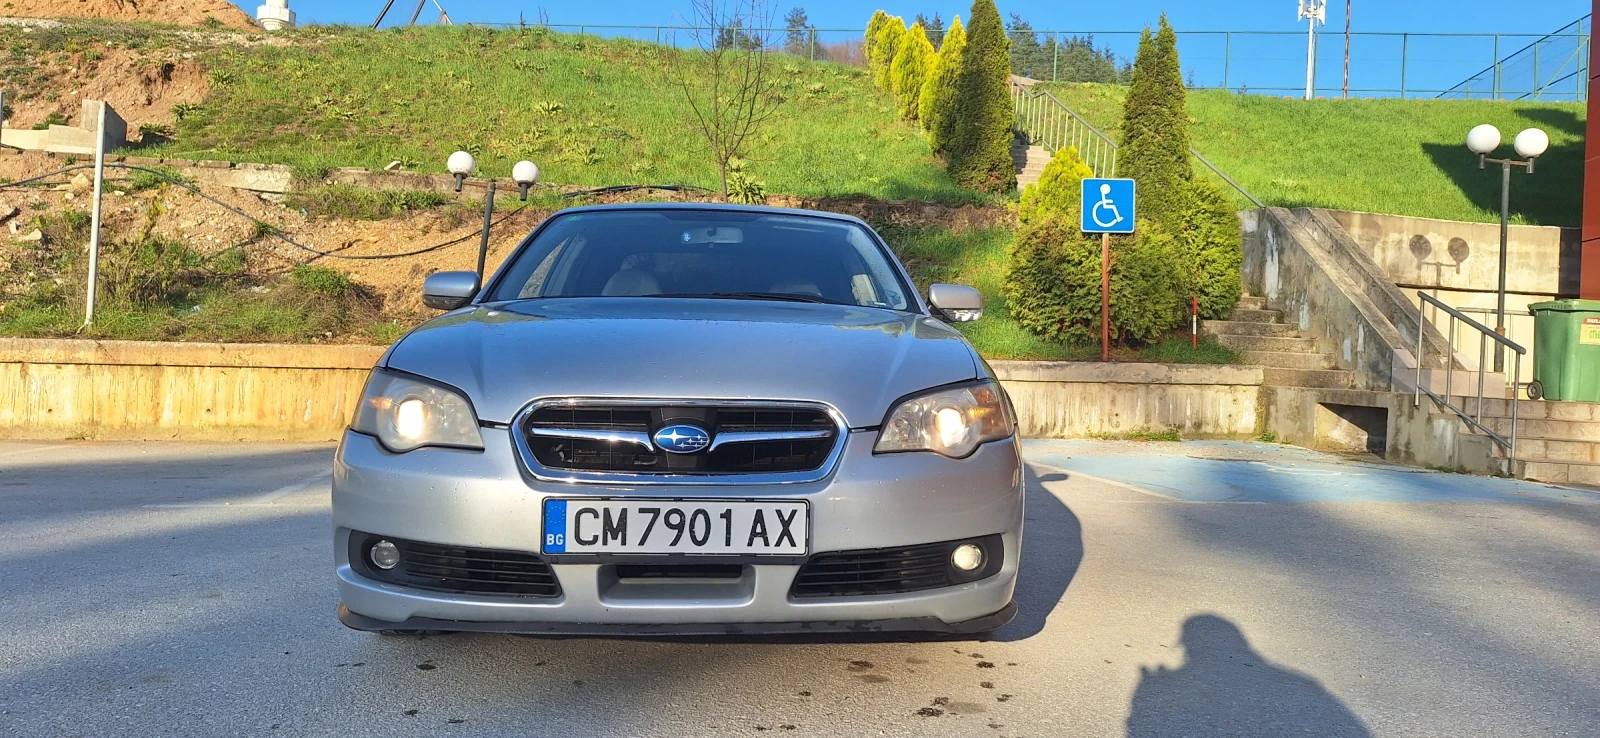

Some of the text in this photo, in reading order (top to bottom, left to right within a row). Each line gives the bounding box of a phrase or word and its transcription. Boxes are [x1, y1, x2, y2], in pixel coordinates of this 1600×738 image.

[546, 533, 564, 546] BG
[574, 507, 798, 547] CM 7901 AX
